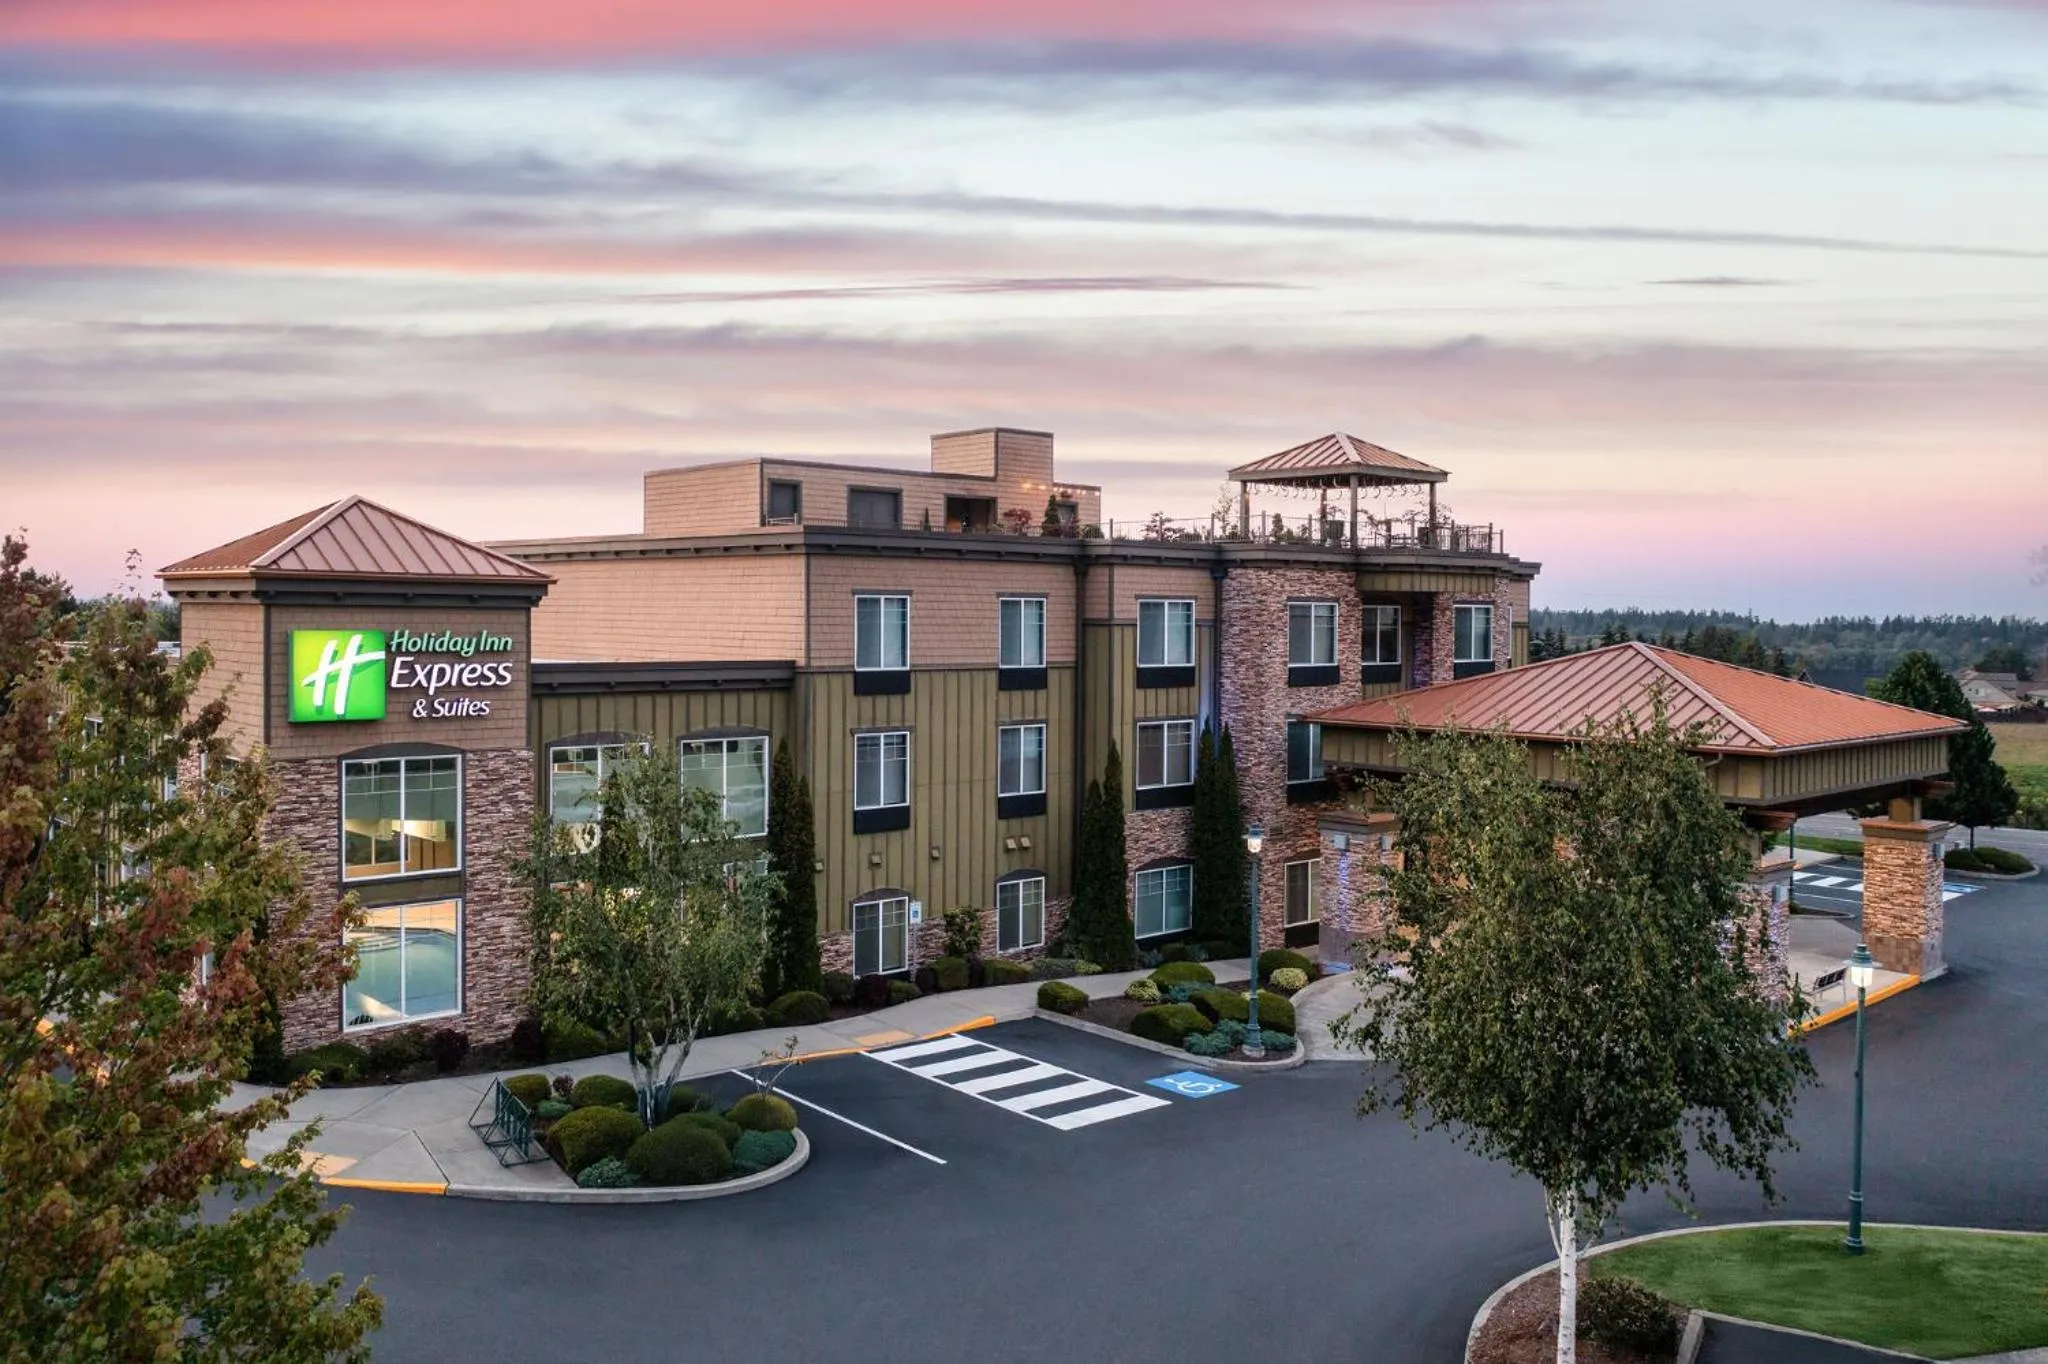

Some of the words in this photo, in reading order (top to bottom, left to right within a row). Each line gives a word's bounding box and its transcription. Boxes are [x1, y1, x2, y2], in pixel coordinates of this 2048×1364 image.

[390, 629, 477, 657] Holiday
[479, 630, 512, 651] Inn
[302, 634, 385, 714] H
[390, 656, 513, 695] Express
[412, 698, 428, 718] &
[432, 697, 491, 717] Suites
